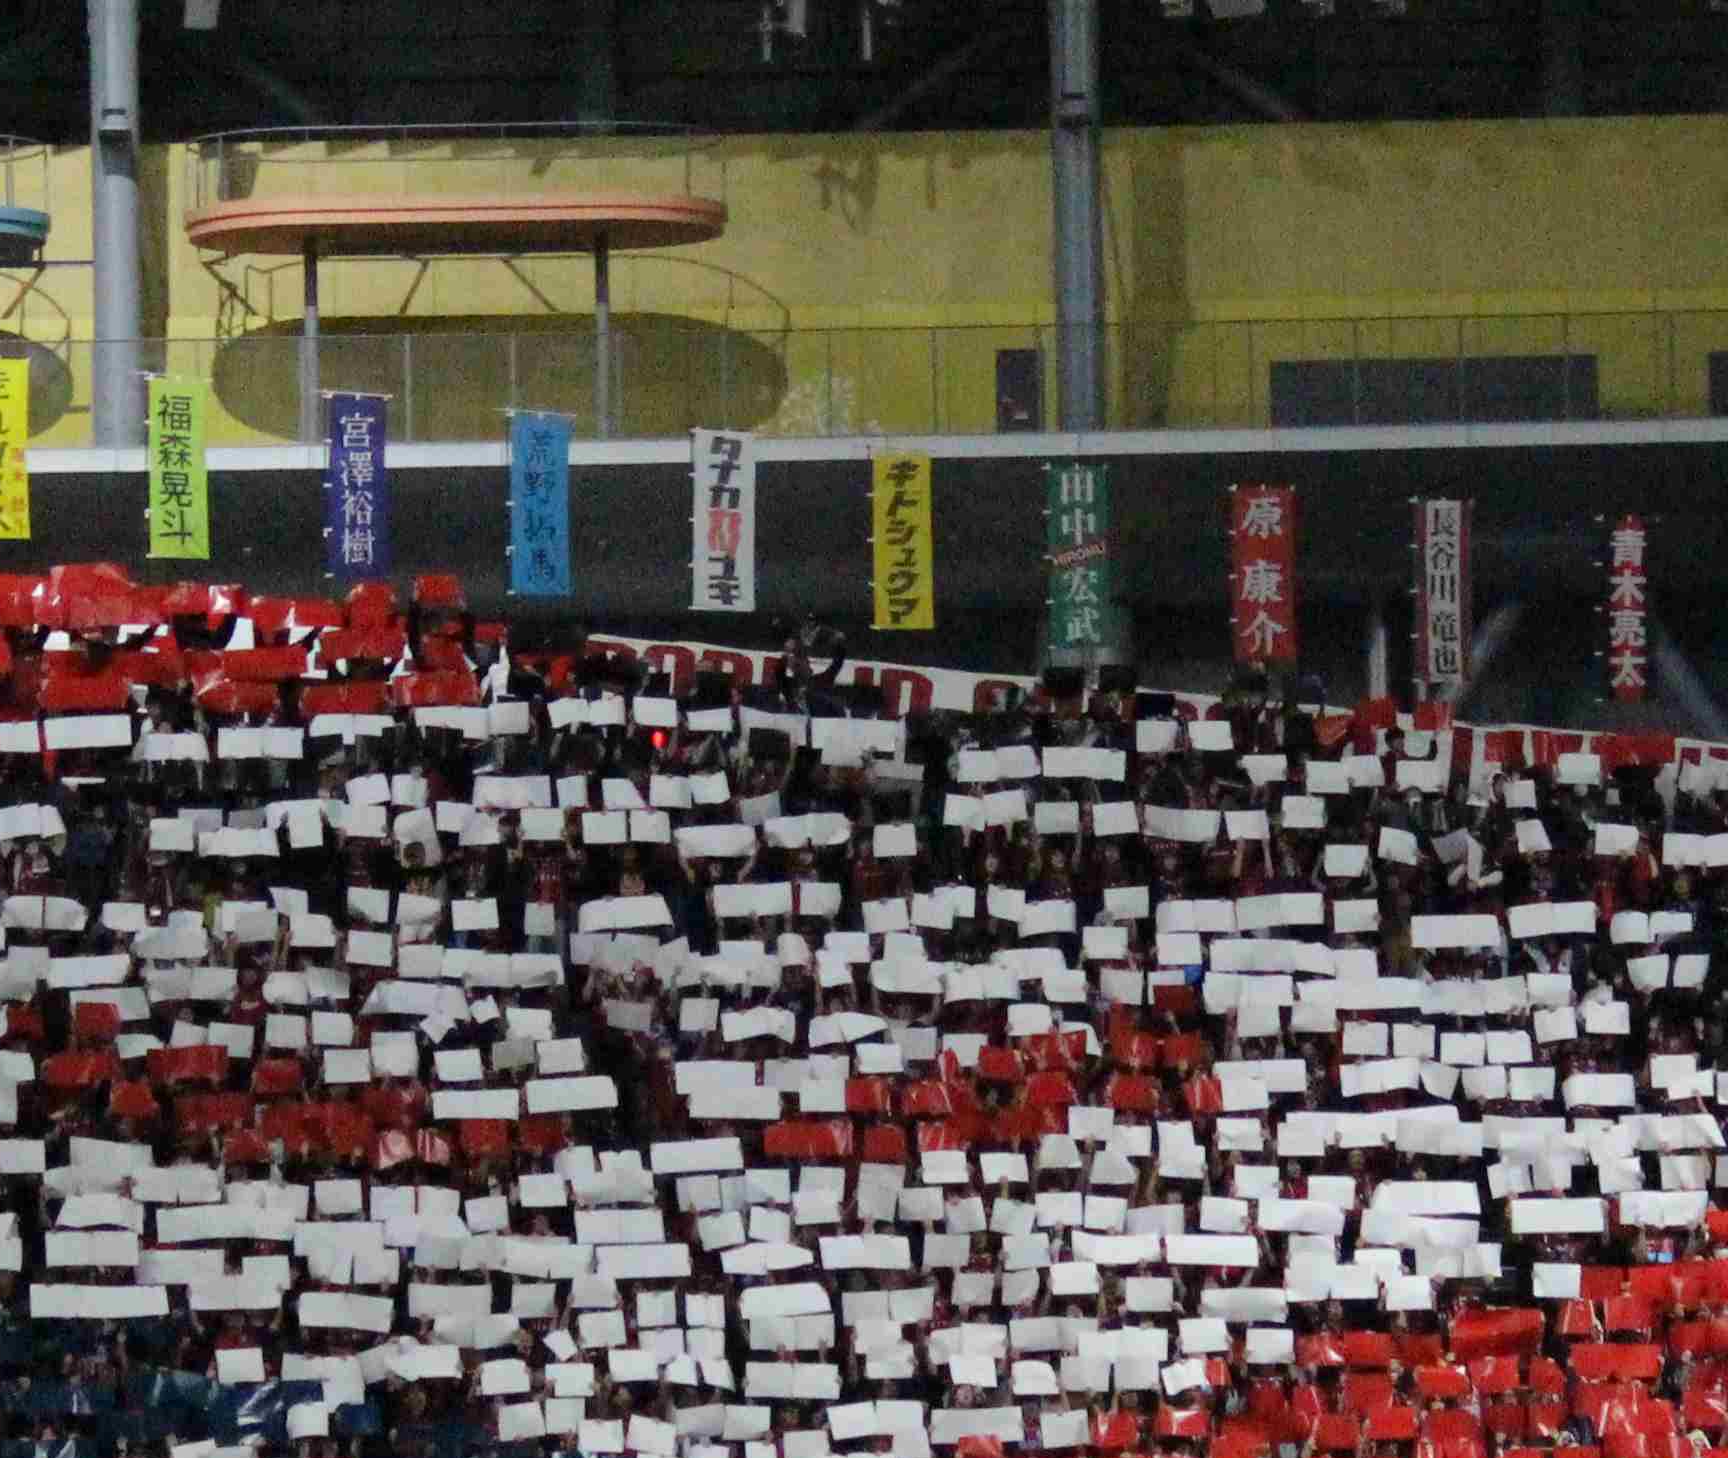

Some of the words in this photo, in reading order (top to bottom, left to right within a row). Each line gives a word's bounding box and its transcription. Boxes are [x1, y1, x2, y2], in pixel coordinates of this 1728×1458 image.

[158, 395, 193, 545] 福森晃斗
[1240, 496, 1288, 656] 原康介
[1609, 530, 1647, 687] 青木亮太
